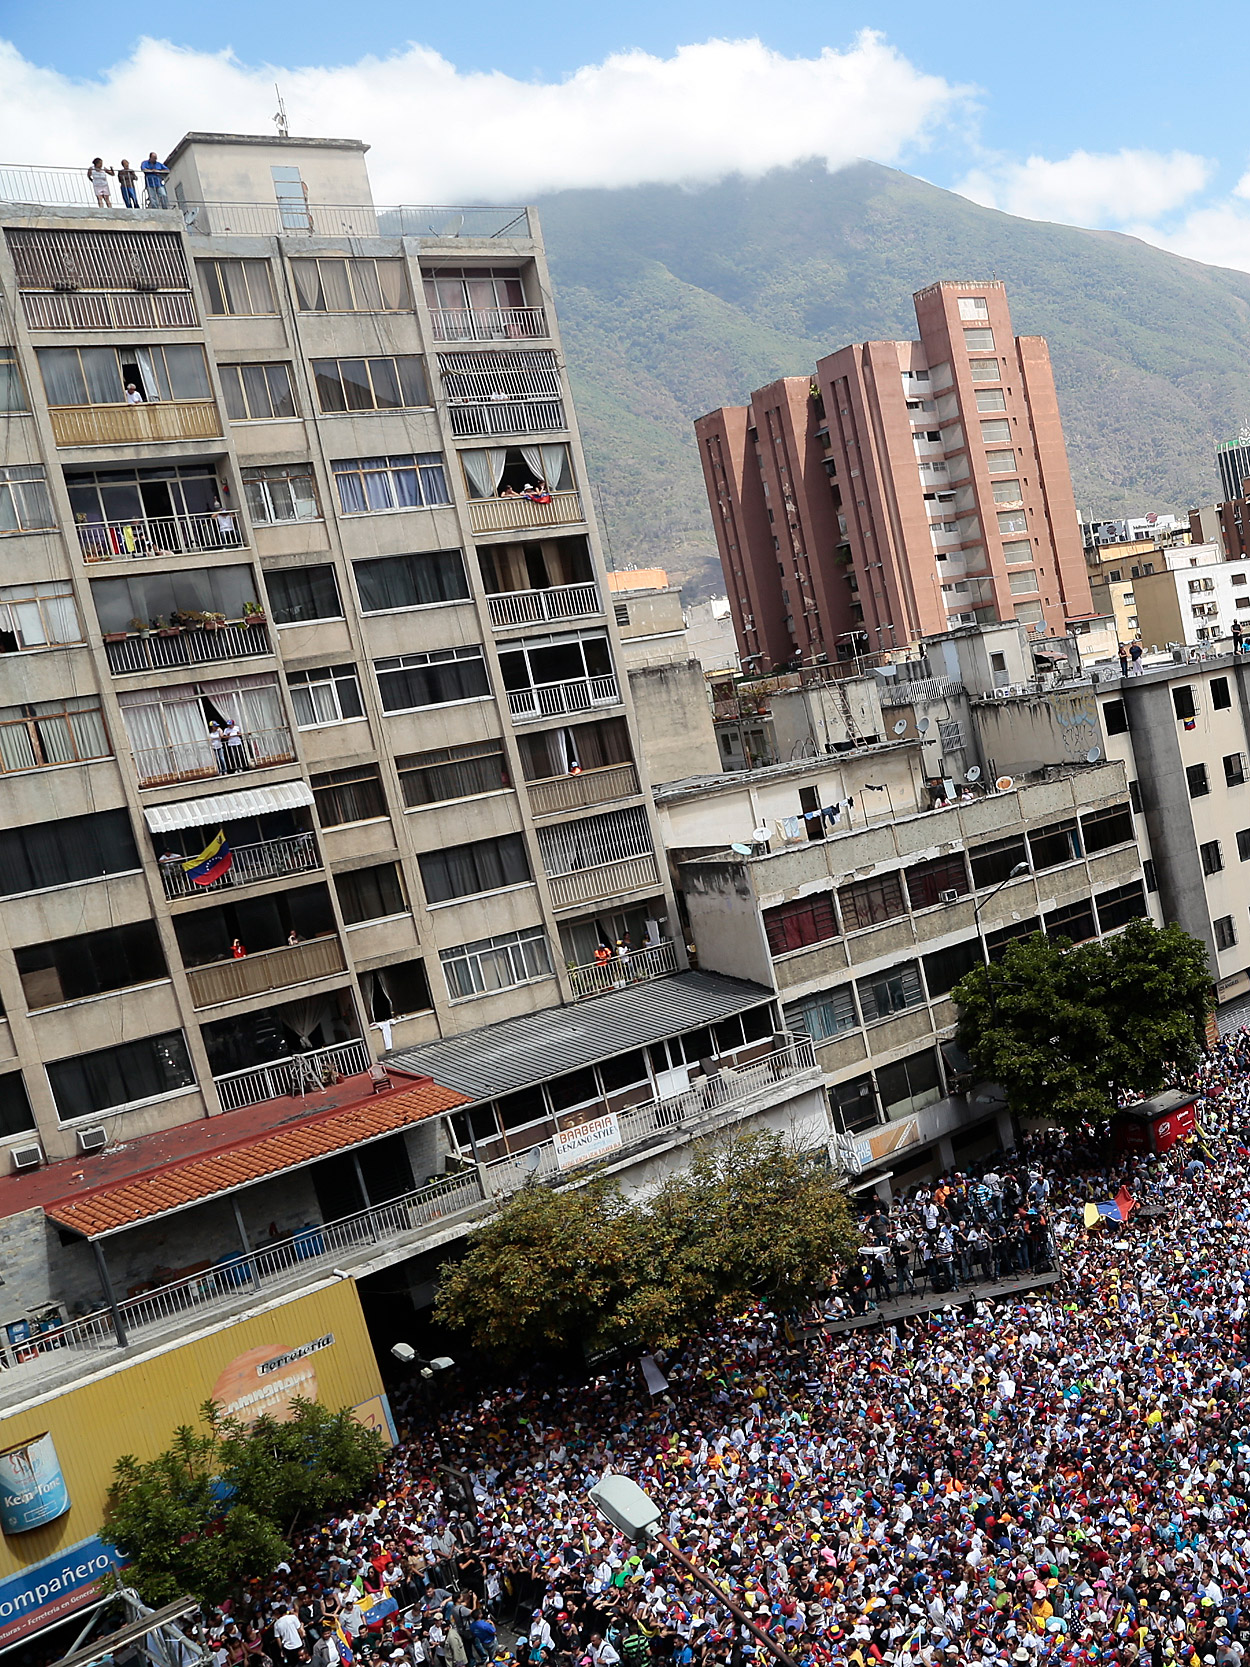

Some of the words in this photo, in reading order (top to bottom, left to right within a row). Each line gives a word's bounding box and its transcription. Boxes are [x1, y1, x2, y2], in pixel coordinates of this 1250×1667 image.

[560, 1116, 612, 1144] BARBERIA
[557, 1134, 593, 1154] GENZANO
[259, 1336, 331, 1374] Ferretería
[61, 1601, 70, 1609] en
[70, 1587, 95, 1604] General
